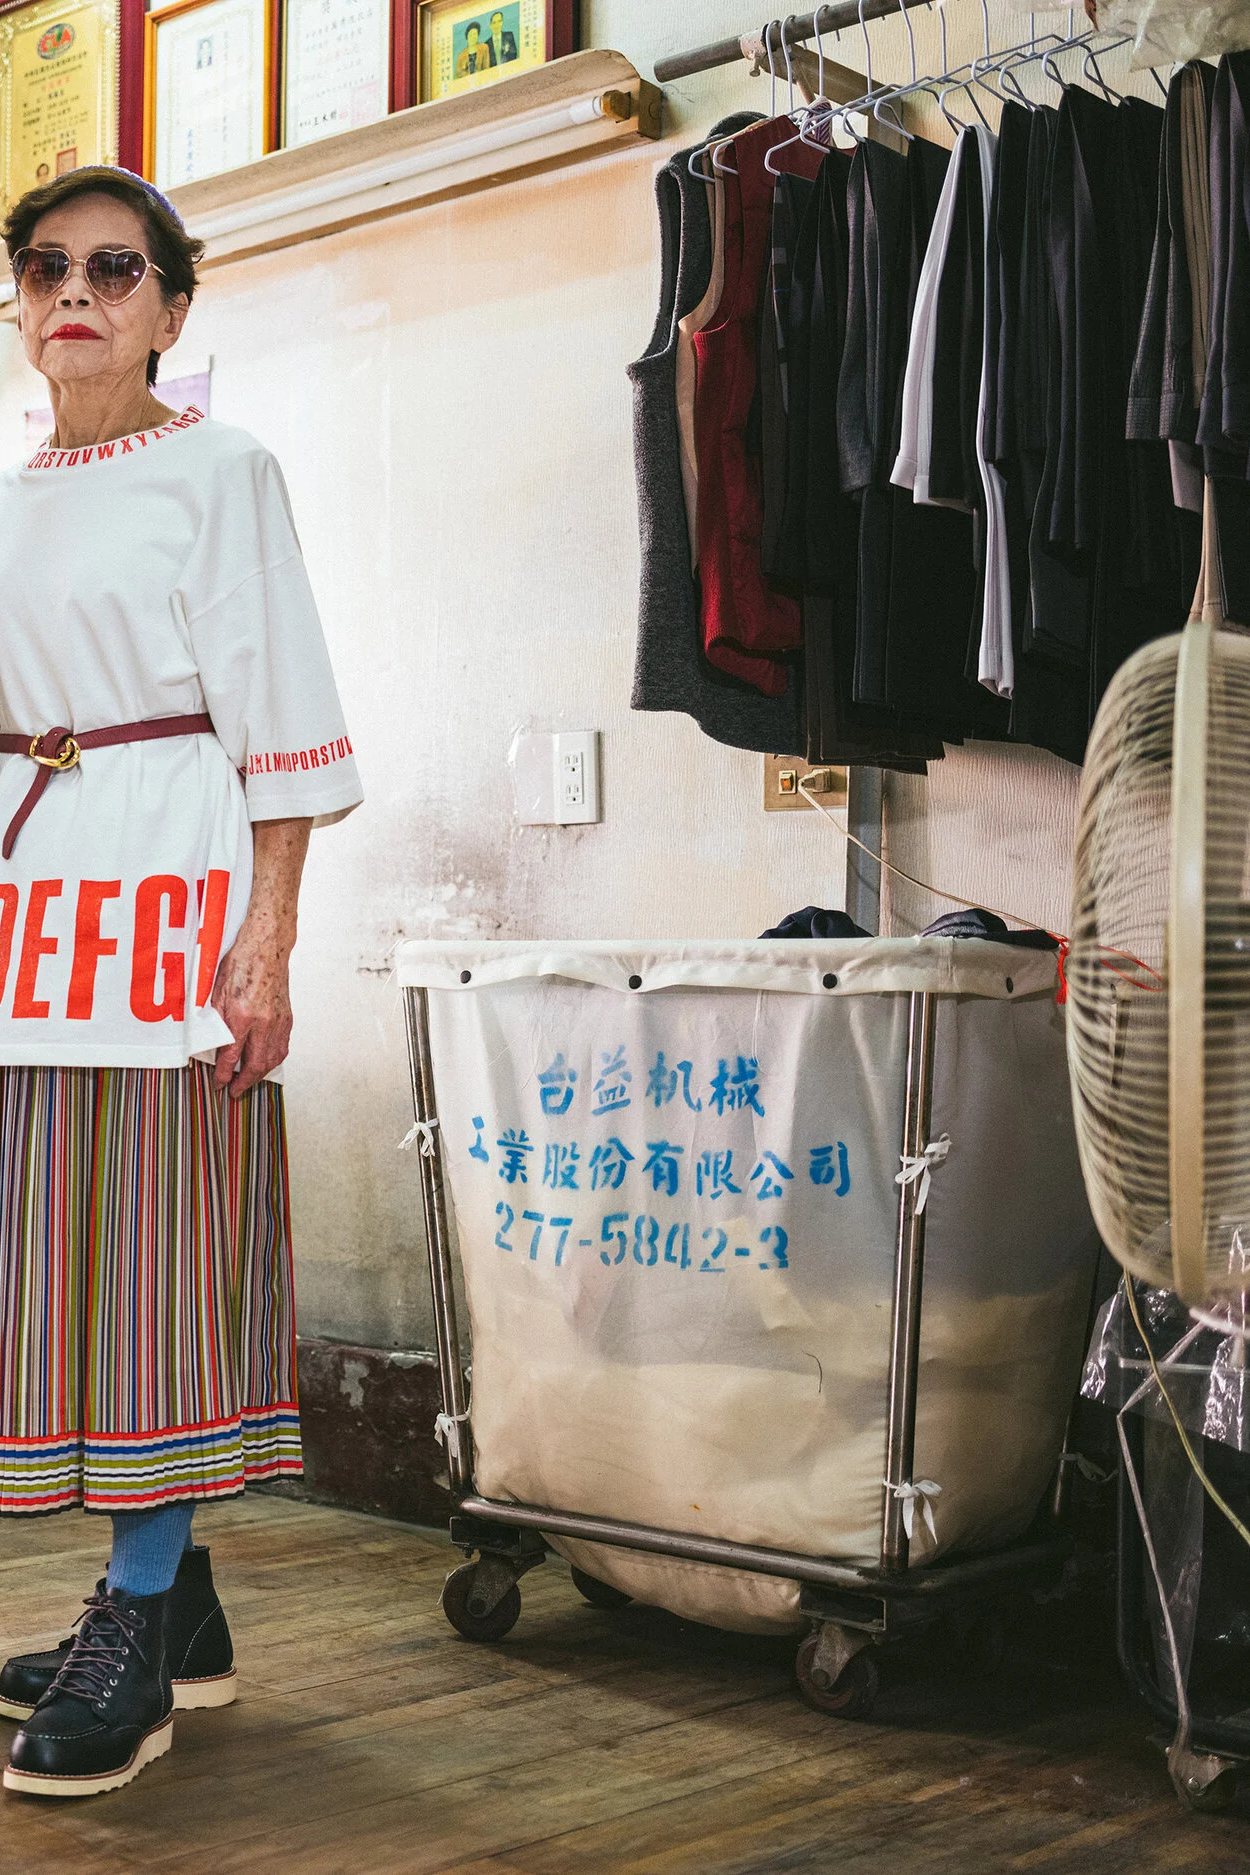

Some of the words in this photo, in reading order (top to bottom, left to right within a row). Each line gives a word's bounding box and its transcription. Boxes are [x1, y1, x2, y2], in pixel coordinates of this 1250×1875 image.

[537, 1043, 766, 1119] 台益机械
[467, 1115, 852, 1202] 工業股份有限公司
